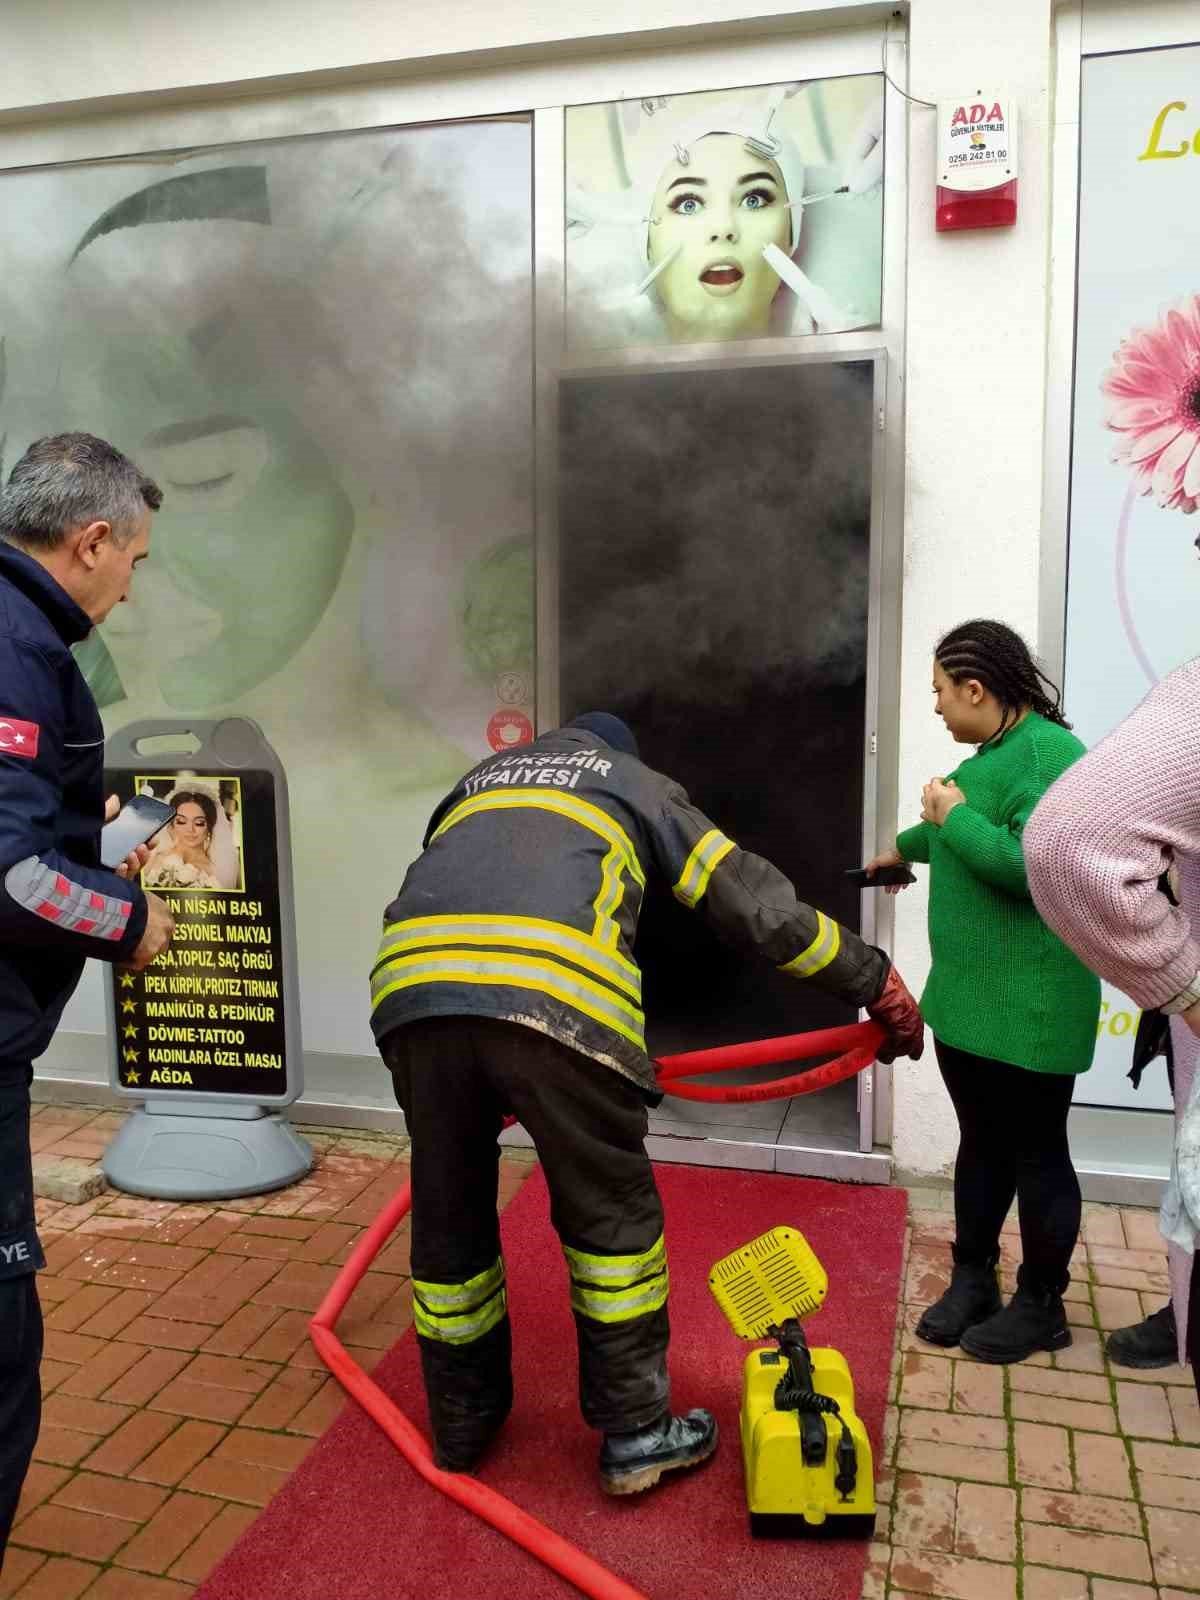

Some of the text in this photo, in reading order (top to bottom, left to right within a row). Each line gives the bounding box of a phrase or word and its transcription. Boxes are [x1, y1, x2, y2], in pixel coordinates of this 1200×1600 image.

[952, 103, 1004, 126] ADA
[949, 153, 968, 163] 0258
[970, 152, 984, 161] 242
[998, 150, 1007, 158] 00
[185, 896, 226, 918] NİŞAN
[230, 901, 263, 920] BAŞI
[226, 925, 272, 944] MAKYAJ
[218, 952, 240, 973] SAÇ
[242, 948, 273, 970] ÖRGÜ
[144, 972, 168, 994] İPEK
[243, 979, 279, 998] TIRNAK
[146, 999, 275, 1022] MANİKÜR & PEDİKÜR
[148, 1023, 245, 1045] DÖVME-TATTOO
[148, 1047, 282, 1069] KADINLARA ÖZEL MASAJ
[150, 1066, 193, 1084] AĞDA
[0, 1241, 30, 1264] YE
